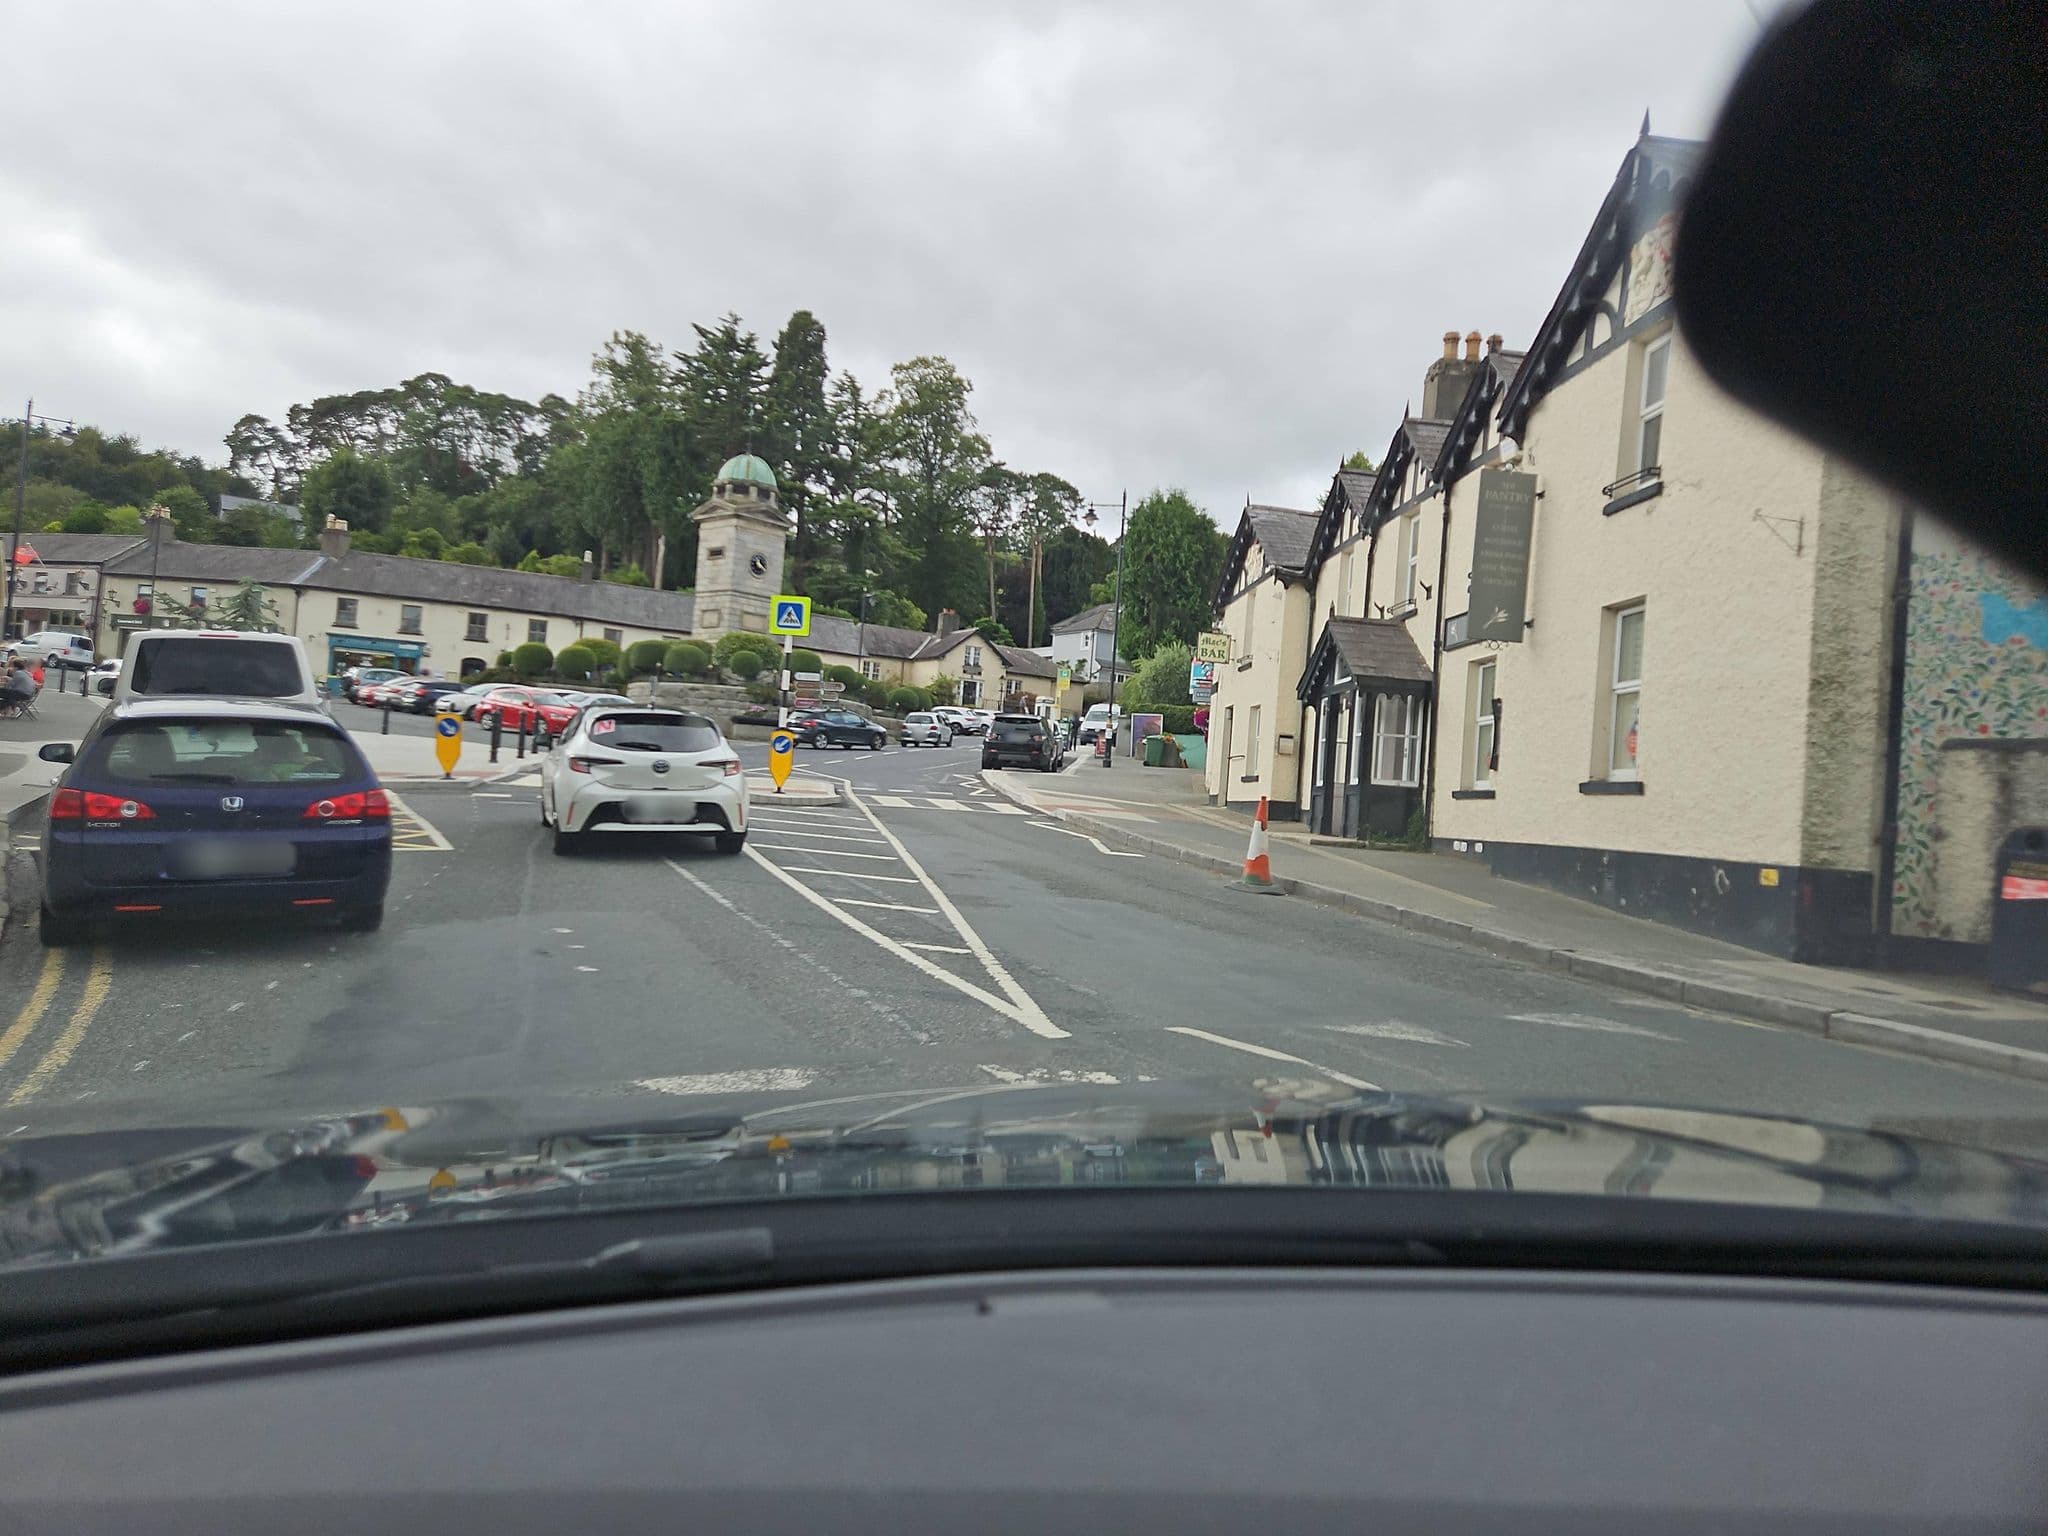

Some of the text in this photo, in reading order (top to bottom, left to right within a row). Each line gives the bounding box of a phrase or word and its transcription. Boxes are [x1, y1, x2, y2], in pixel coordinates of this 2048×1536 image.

[1485, 489, 1530, 504] PANTRY
[1202, 637, 1227, 647] Mac's
[1200, 648, 1226, 659] BAR
